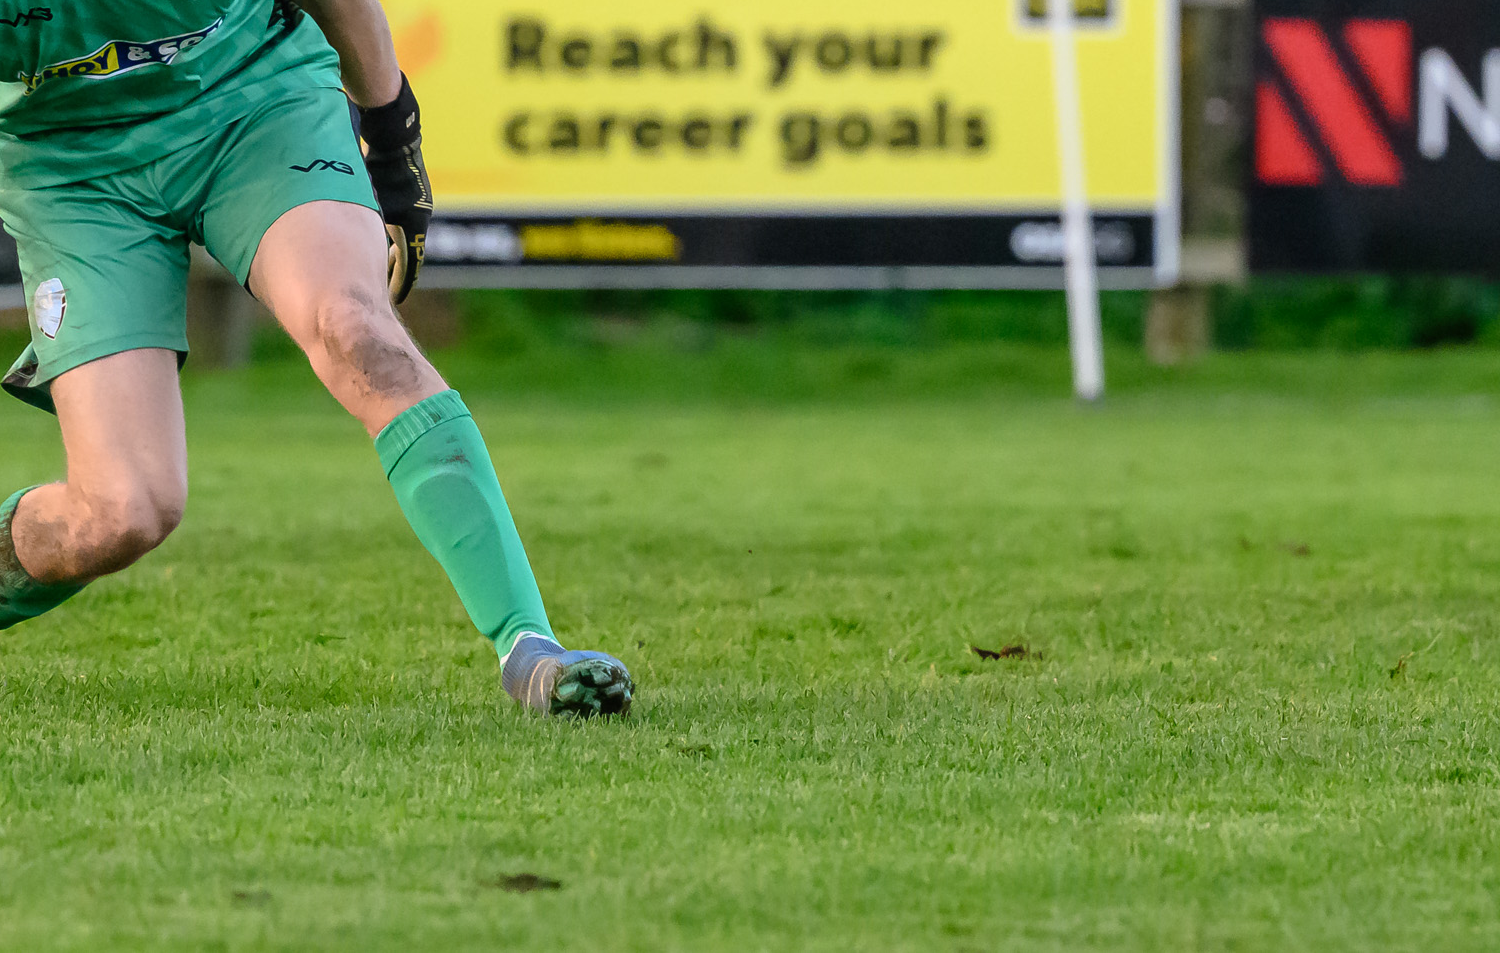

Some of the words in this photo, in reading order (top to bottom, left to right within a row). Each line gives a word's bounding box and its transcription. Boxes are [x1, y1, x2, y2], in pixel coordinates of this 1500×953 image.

[128, 47, 151, 61] &
[503, 17, 738, 74] Reach
[760, 26, 946, 87] your
[503, 109, 754, 156] career
[777, 95, 992, 167] goals
